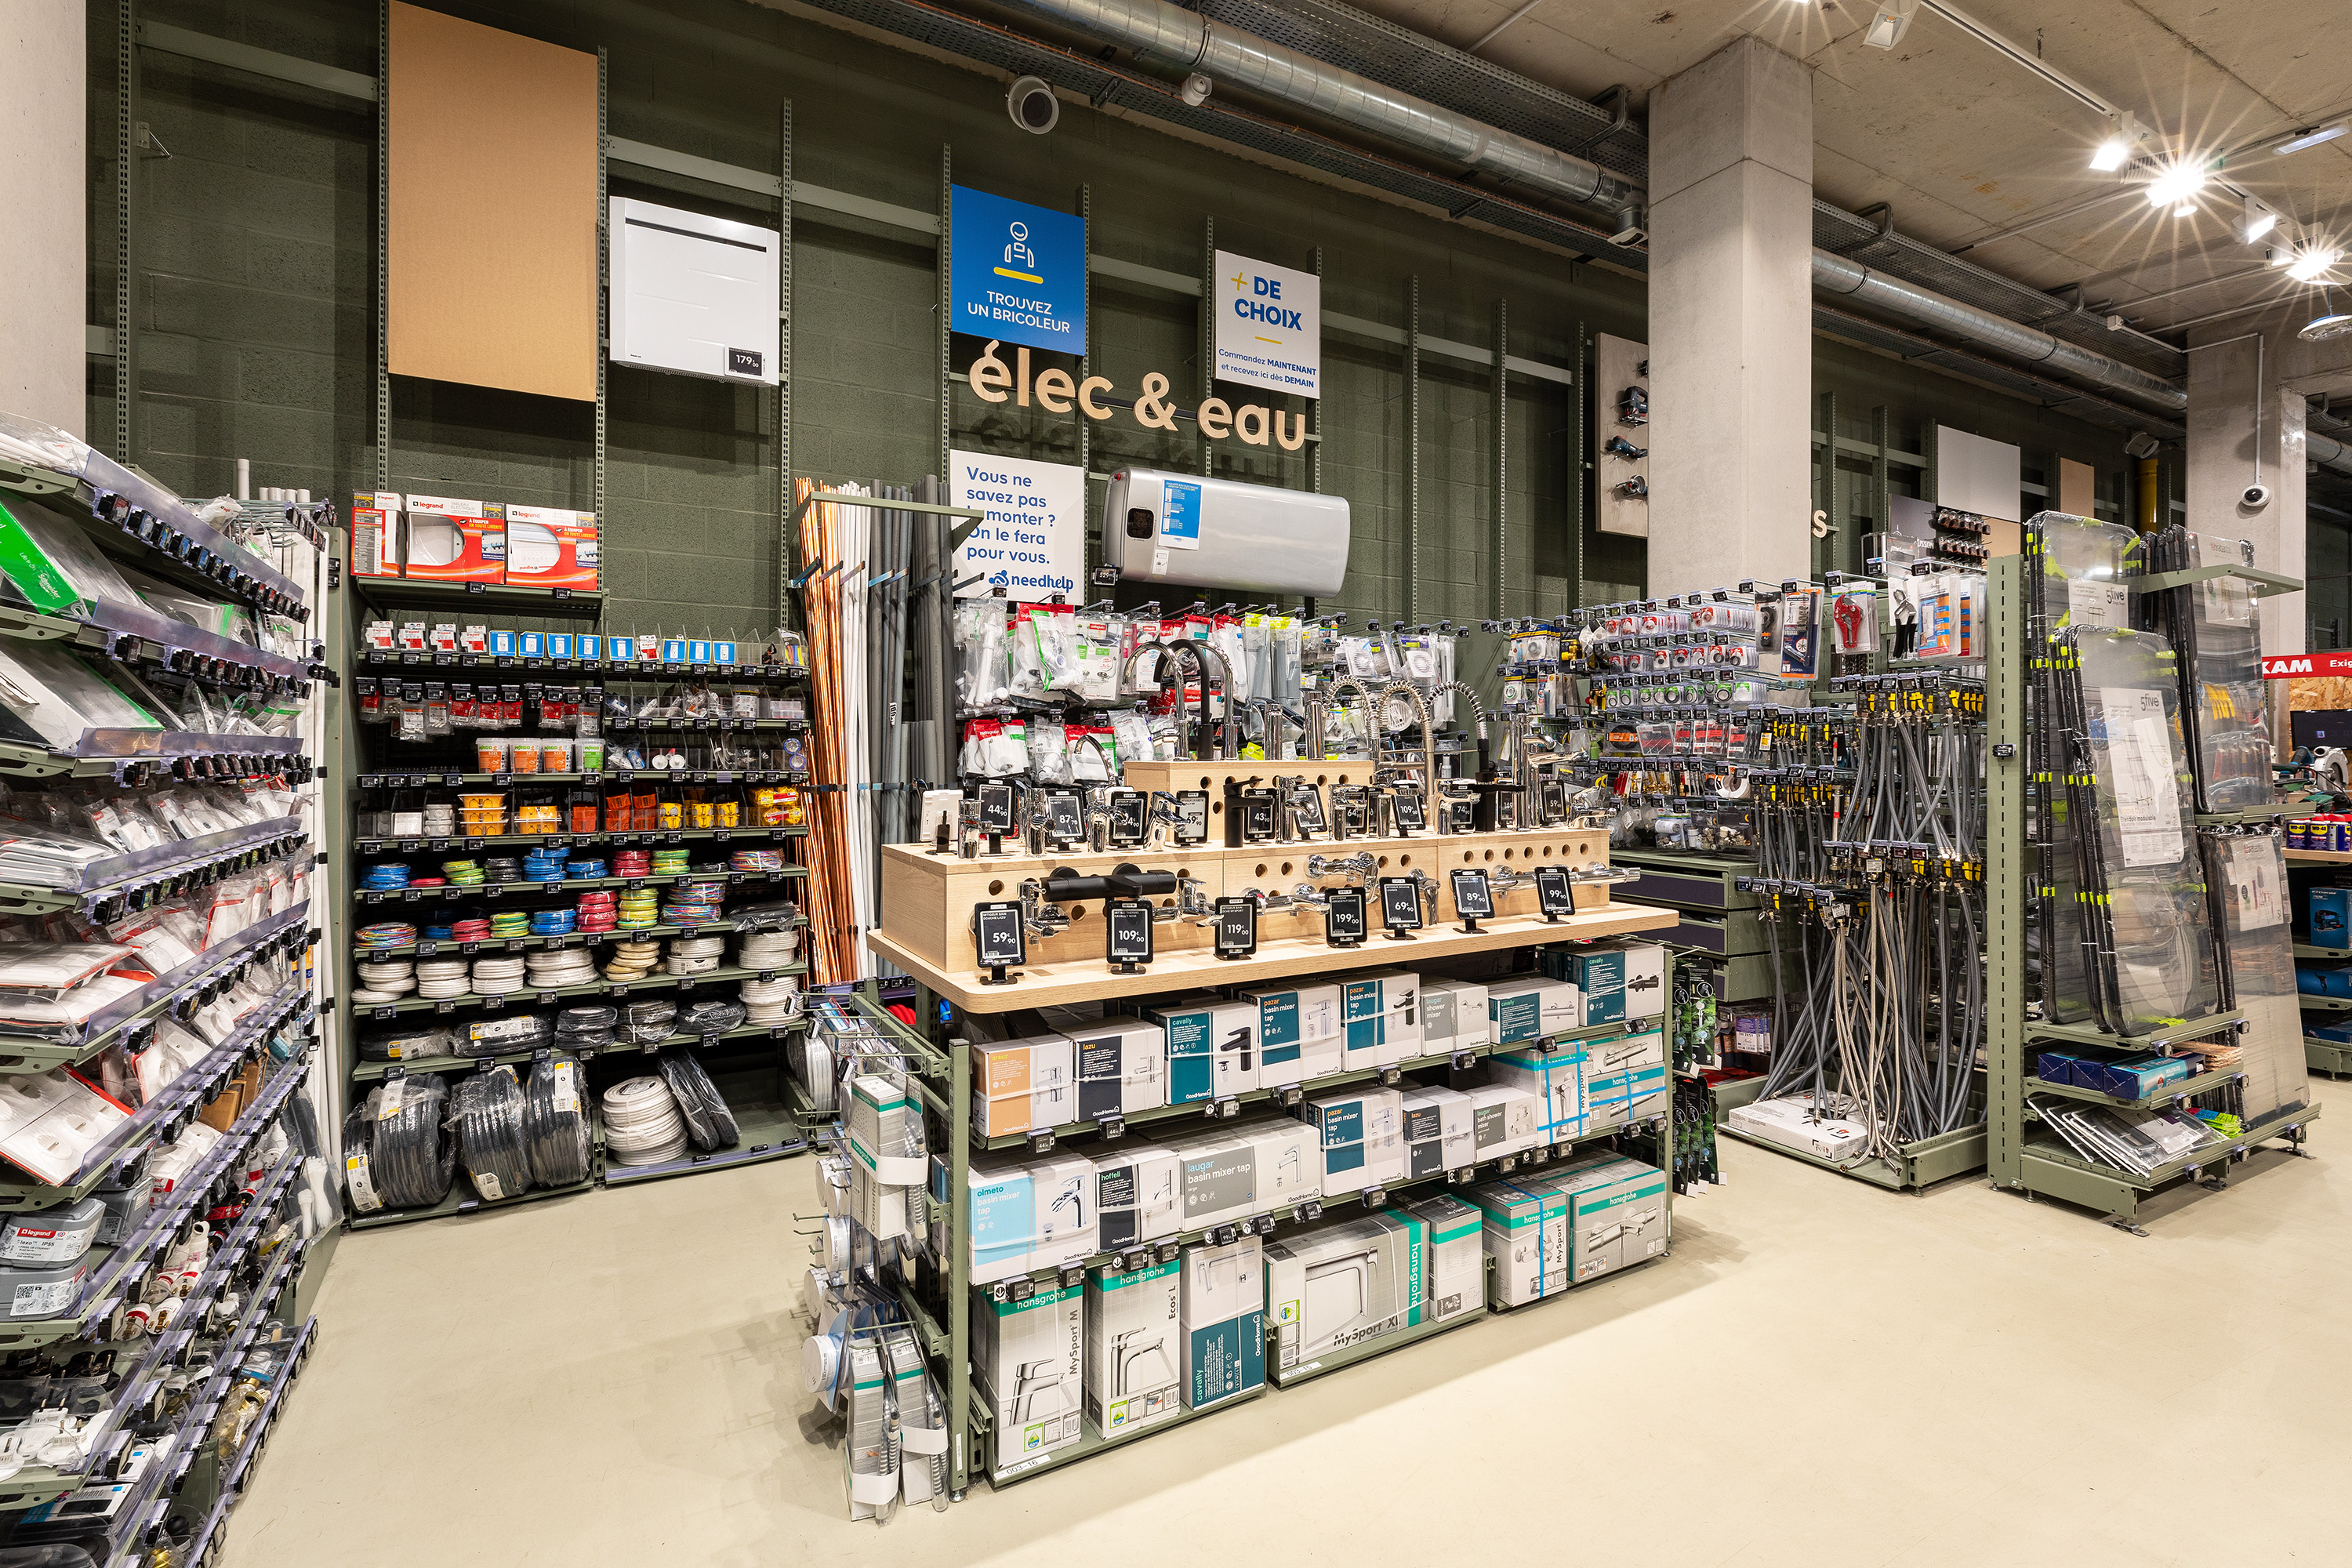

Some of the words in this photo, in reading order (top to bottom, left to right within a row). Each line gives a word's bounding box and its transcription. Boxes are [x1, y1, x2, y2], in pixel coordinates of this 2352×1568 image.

[1254, 276, 1281, 300] DE
[986, 291, 1052, 315] TROUVEZ
[967, 302, 989, 318] UN
[993, 307, 1070, 333] BRICOLEUR
[1234, 298, 1302, 331] CHOIX
[1218, 348, 1265, 365] Commandez
[1267, 358, 1316, 376] MAINTENANT
[1230, 366, 1259, 377] recevez
[1270, 372, 1283, 382] dès
[1284, 376, 1314, 388] DEMAIN
[969, 339, 1114, 419] élec
[1133, 372, 1178, 431] &
[1197, 397, 1305, 451] eau
[967, 466, 1007, 485] Vous
[1013, 475, 1032, 487] ne
[967, 489, 1013, 504] savez
[1018, 495, 1047, 508] pas
[986, 510, 1044, 526] monter
[1048, 514, 1055, 527] ?
[996, 528, 1009, 541] le
[1014, 530, 1045, 545] fera
[967, 546, 1004, 560] pour
[1009, 550, 1050, 564] vous.
[38, 572, 61, 598] Schneider
[1011, 575, 1074, 593] needhelp
[2106, 587, 2125, 604] 5five
[2141, 694, 2159, 711] 5five
[1349, 985, 1364, 994] pazar
[1264, 998, 1279, 1007] pazar
[1426, 996, 1442, 1005] laugar
[1426, 1003, 1446, 1011] shower
[1264, 1005, 1279, 1014] basin
[1612, 1073, 1638, 1085] hansgohe
[1185, 1091, 1207, 1100] GoodHome
[1093, 1108, 1114, 1117] GoodHome
[1327, 1108, 1343, 1116] pazar
[1343, 1112, 1358, 1121] mixer
[1486, 1112, 1503, 1120] shower
[852, 1142, 872, 1164] hansgrohe
[1188, 1160, 1214, 1173] laugar
[1188, 1173, 1211, 1184] basin
[1212, 1167, 1235, 1178] mixer
[1236, 1163, 1250, 1174] tap
[1101, 1171, 1121, 1181] hoffell
[977, 1186, 1004, 1196] olmeto
[977, 1196, 997, 1206] basin
[999, 1191, 1020, 1202] mixer
[1288, 1192, 1313, 1203] GoodHome
[1610, 1192, 1637, 1205] hansgrohe
[978, 1206, 990, 1215] tap
[1523, 1210, 1554, 1224] hansgohe
[1112, 1236, 1134, 1244] GoodHome
[1064, 1252, 1087, 1261] GoodHome
[1120, 1266, 1165, 1285] hansgrohe
[1411, 1243, 1421, 1308] hansgrohe
[1017, 1290, 1066, 1309] hansgrohe
[1168, 1295, 1177, 1320] Ecos
[1070, 1309, 1078, 1320] M
[1334, 1323, 1382, 1346] MySport
[1069, 1325, 1078, 1374] MySport
[1006, 1459, 1038, 1475] 003-16
